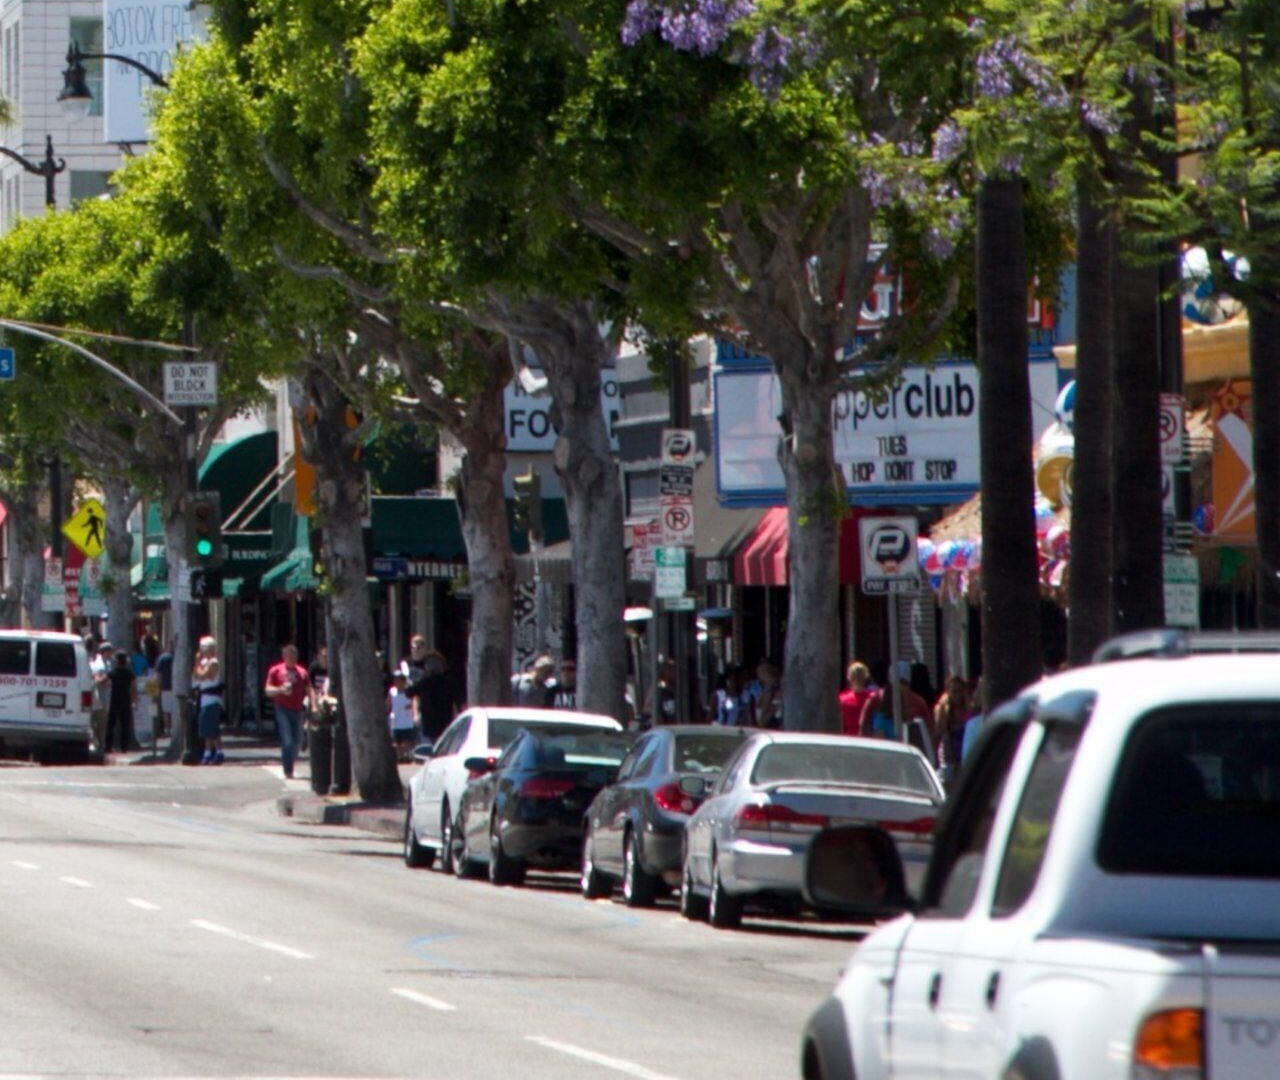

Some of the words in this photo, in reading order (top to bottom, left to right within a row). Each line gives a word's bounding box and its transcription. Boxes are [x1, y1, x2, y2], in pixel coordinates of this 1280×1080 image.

[171, 366, 185, 378] DO
[189, 366, 208, 378] NOT
[174, 380, 206, 391] BLOCK
[877, 435, 907, 456] TUES
[851, 461, 875, 482] HOP
[885, 460, 915, 481] DONT
[925, 459, 957, 481] STOP
[406, 561, 464, 578] NTERNET
